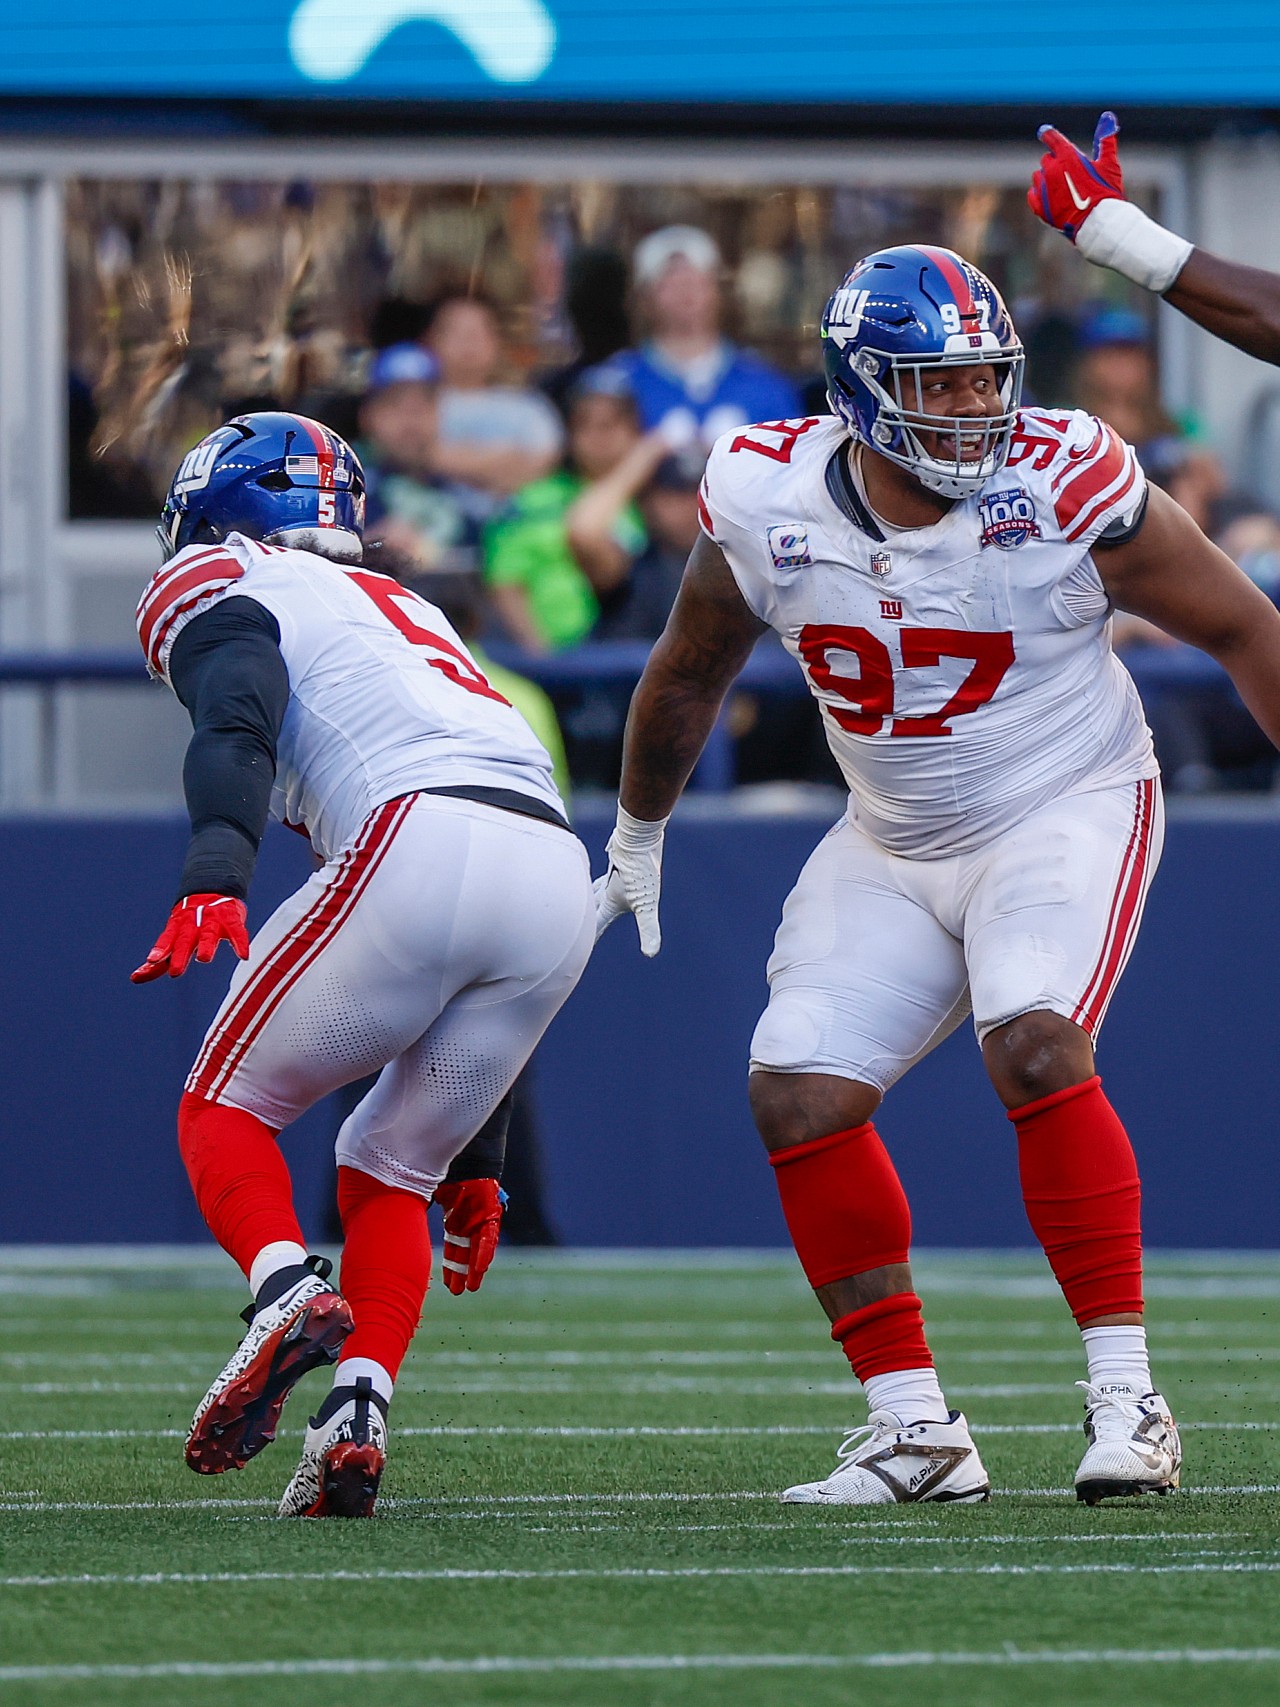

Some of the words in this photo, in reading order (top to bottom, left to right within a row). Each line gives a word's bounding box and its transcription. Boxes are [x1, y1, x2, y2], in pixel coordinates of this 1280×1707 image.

[318, 493, 335, 524] 5
[980, 497, 1035, 529] 100
[987, 521, 1032, 535] SEASONS
[872, 561, 890, 574] NFL
[798, 623, 1016, 736] 97
[909, 1459, 942, 1491] ALPHA
